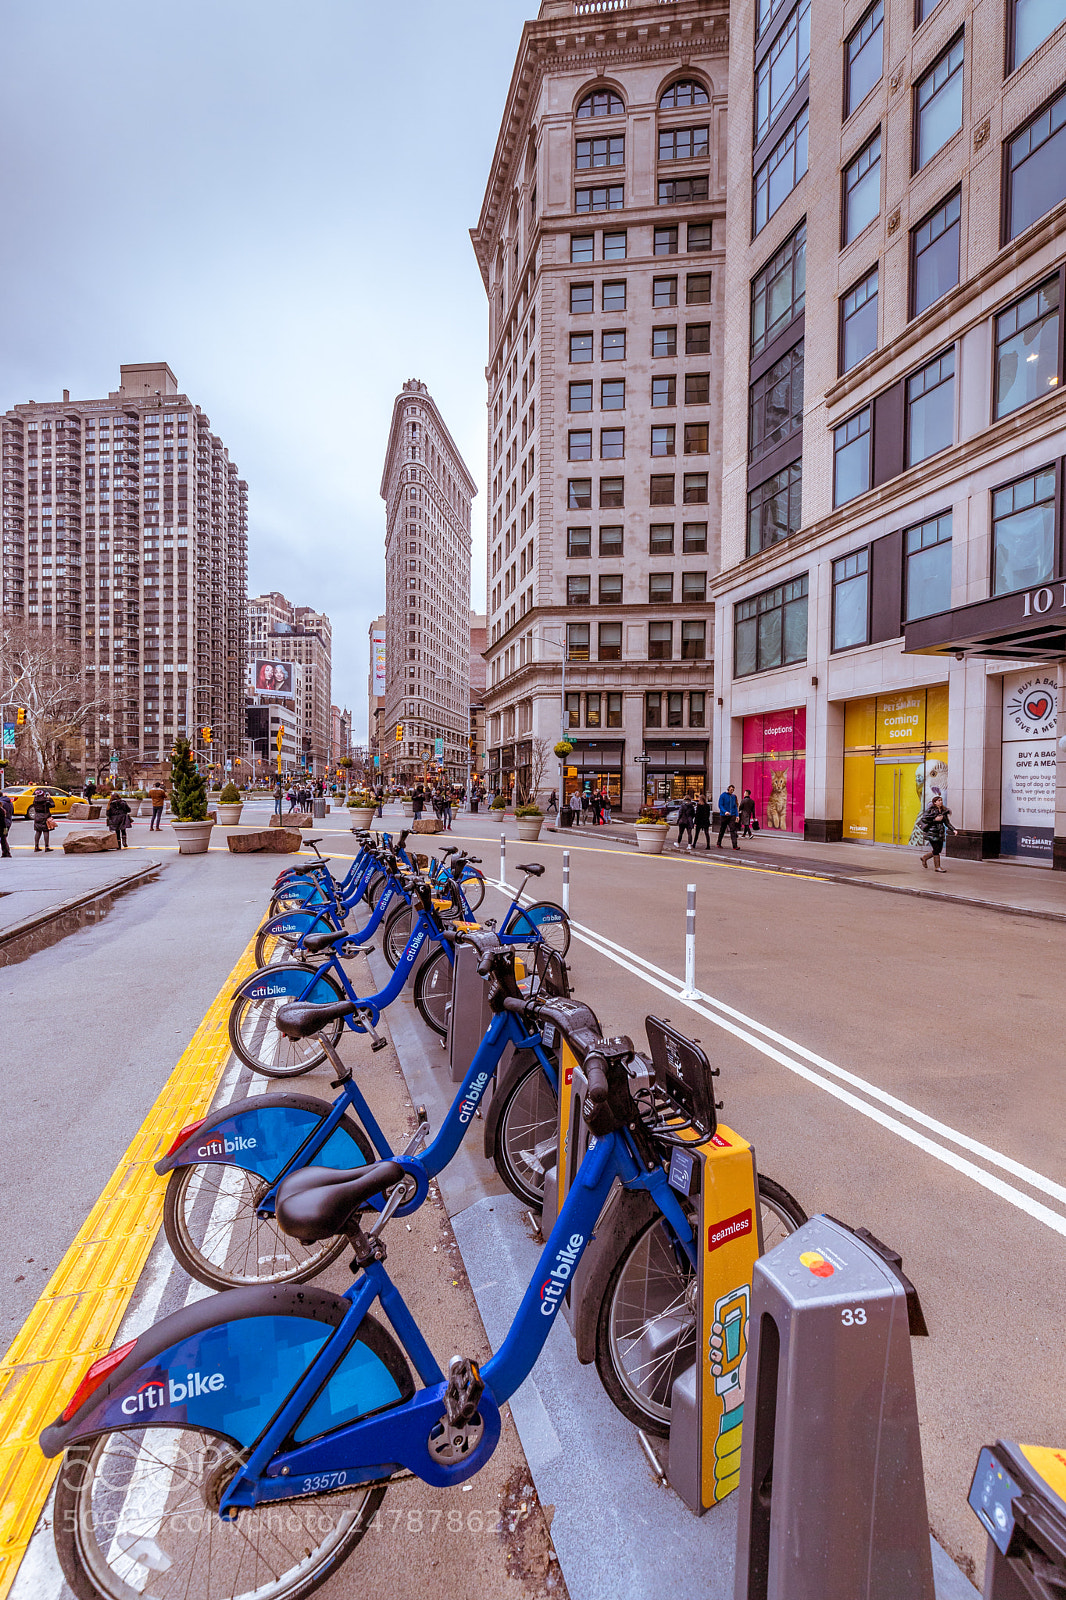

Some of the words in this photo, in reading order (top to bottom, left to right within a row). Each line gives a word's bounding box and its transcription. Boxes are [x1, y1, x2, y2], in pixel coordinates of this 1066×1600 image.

[1022, 588, 1054, 617] 10
[1017, 681, 1032, 694] BUY
[1043, 678, 1058, 689] BAG
[883, 700, 921, 712] PETSMART
[884, 714, 919, 725] coming
[1015, 717, 1031, 733] GIVE
[764, 726, 793, 736] adoptions
[889, 728, 912, 738] soon
[411, 932, 424, 949] bike
[251, 986, 267, 997] citi
[267, 985, 287, 995] bike
[465, 1072, 488, 1102] bike
[459, 1099, 476, 1123] citi
[197, 1139, 222, 1157] citi
[224, 1136, 257, 1153] bike
[711, 1218, 749, 1243] seamless
[550, 1233, 584, 1280] bike
[540, 1278, 565, 1316] citi
[841, 1308, 867, 1326] 33
[121, 1381, 165, 1415] citi
[168, 1372, 226, 1404] bike
[302, 1471, 347, 1493] 33570
